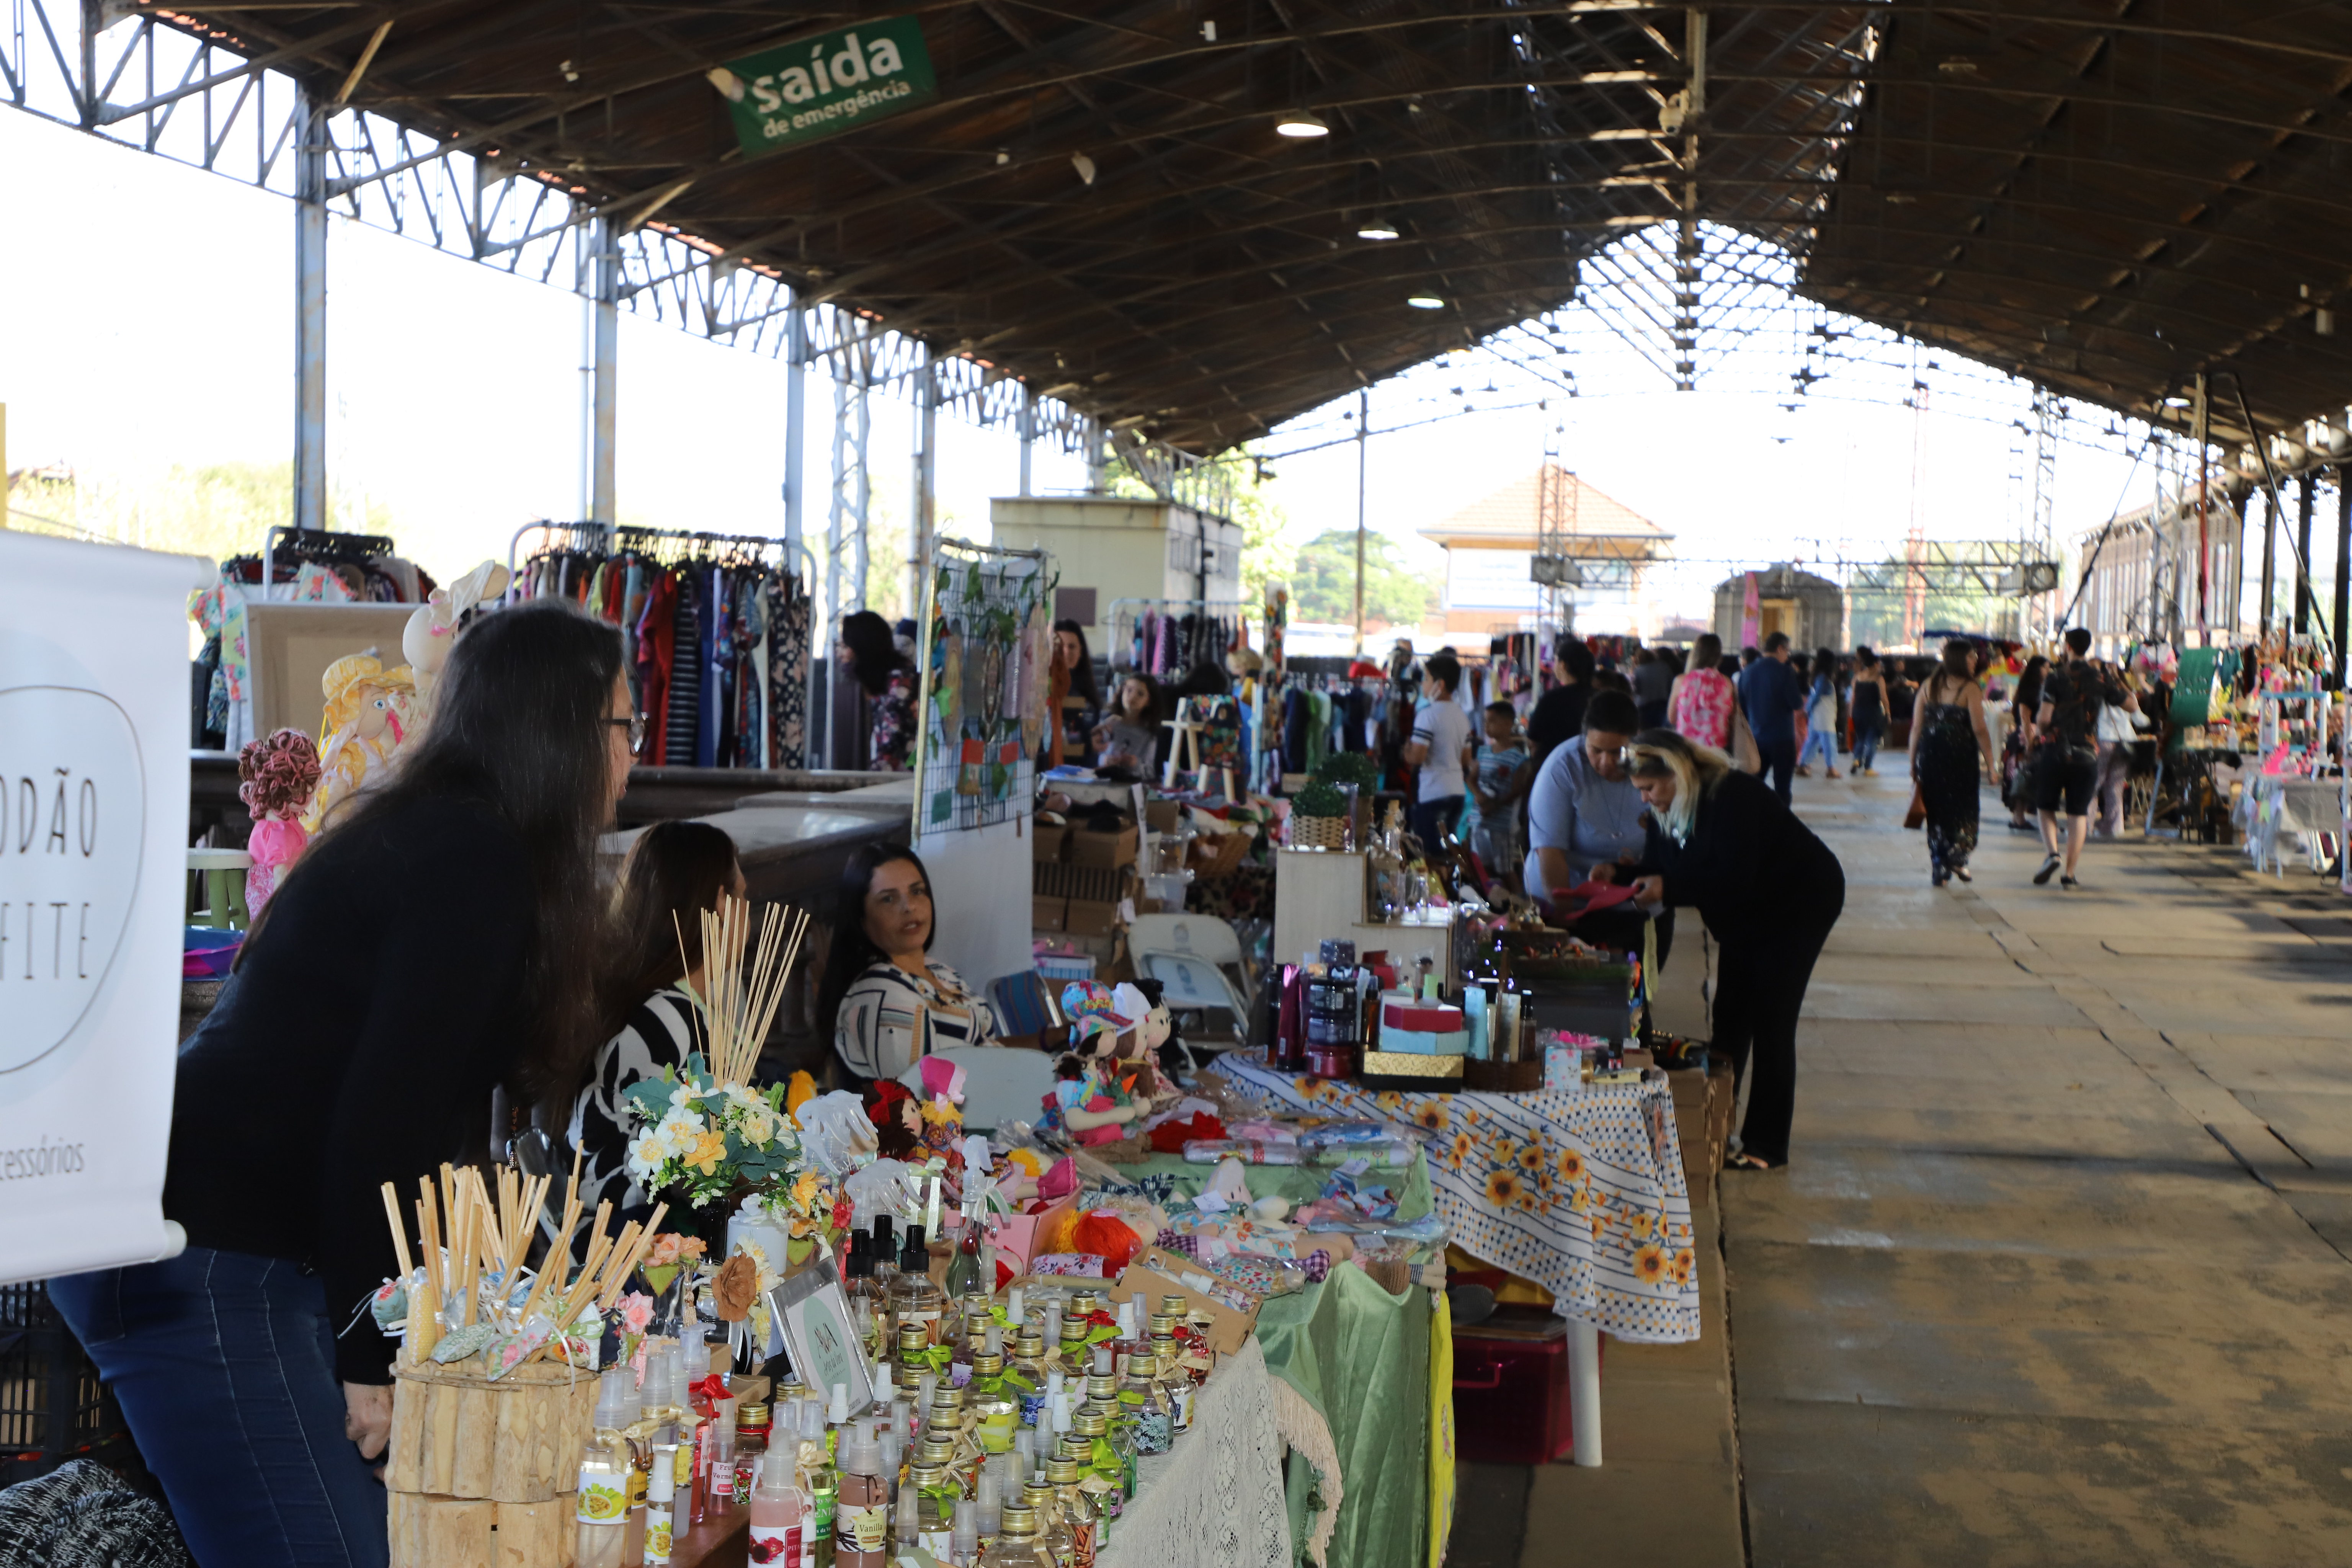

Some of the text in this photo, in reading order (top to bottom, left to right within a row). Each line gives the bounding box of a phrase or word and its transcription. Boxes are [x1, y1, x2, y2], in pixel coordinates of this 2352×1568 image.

[751, 33, 904, 114] saída
[763, 80, 911, 139] de emergência
[859, 1523, 882, 1532] Vanilla
